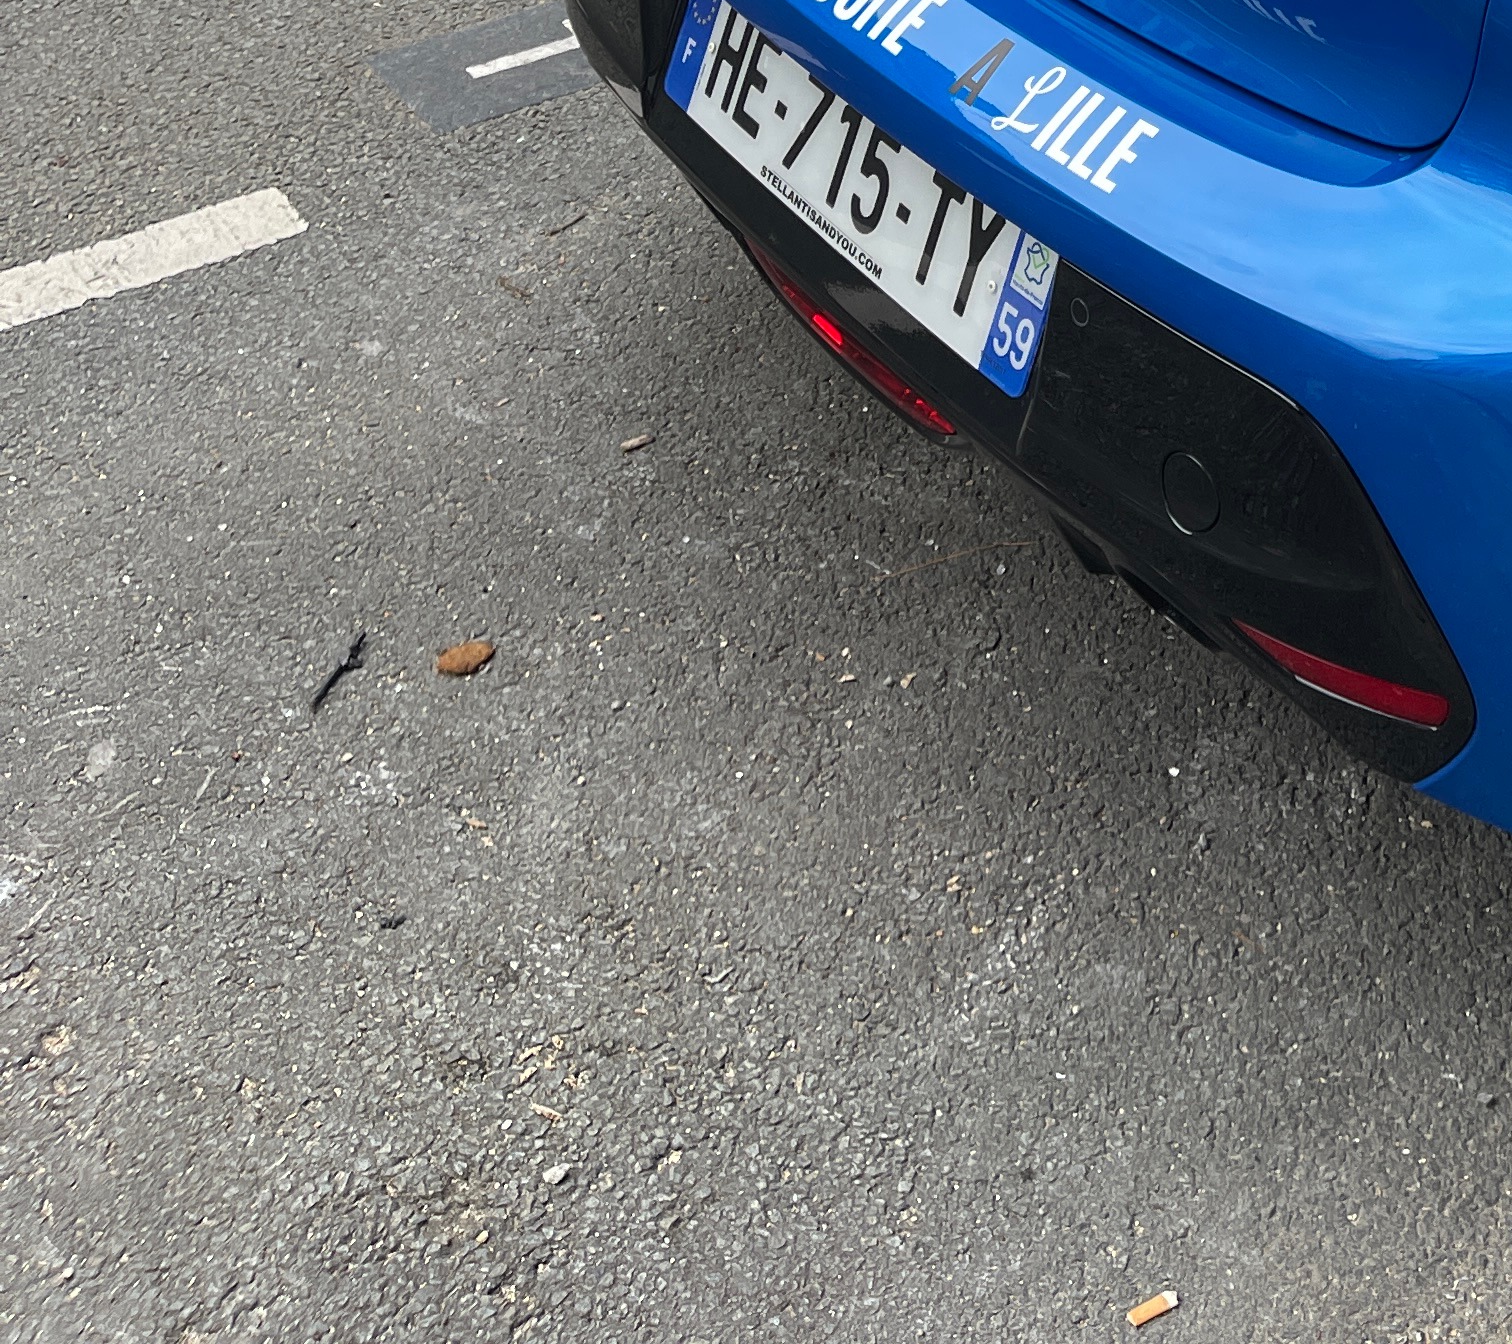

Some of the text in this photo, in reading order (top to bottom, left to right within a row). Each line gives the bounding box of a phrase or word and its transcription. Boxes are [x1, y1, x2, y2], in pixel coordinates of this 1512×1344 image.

[681, 37, 697, 63] F
[704, 7, 1006, 318] HE-715-TY
[949, 38, 1016, 106] A
[990, 66, 1160, 194] LILLE
[760, 165, 883, 280] STELLANTISANDYOU.COM
[992, 301, 1036, 371] 59
